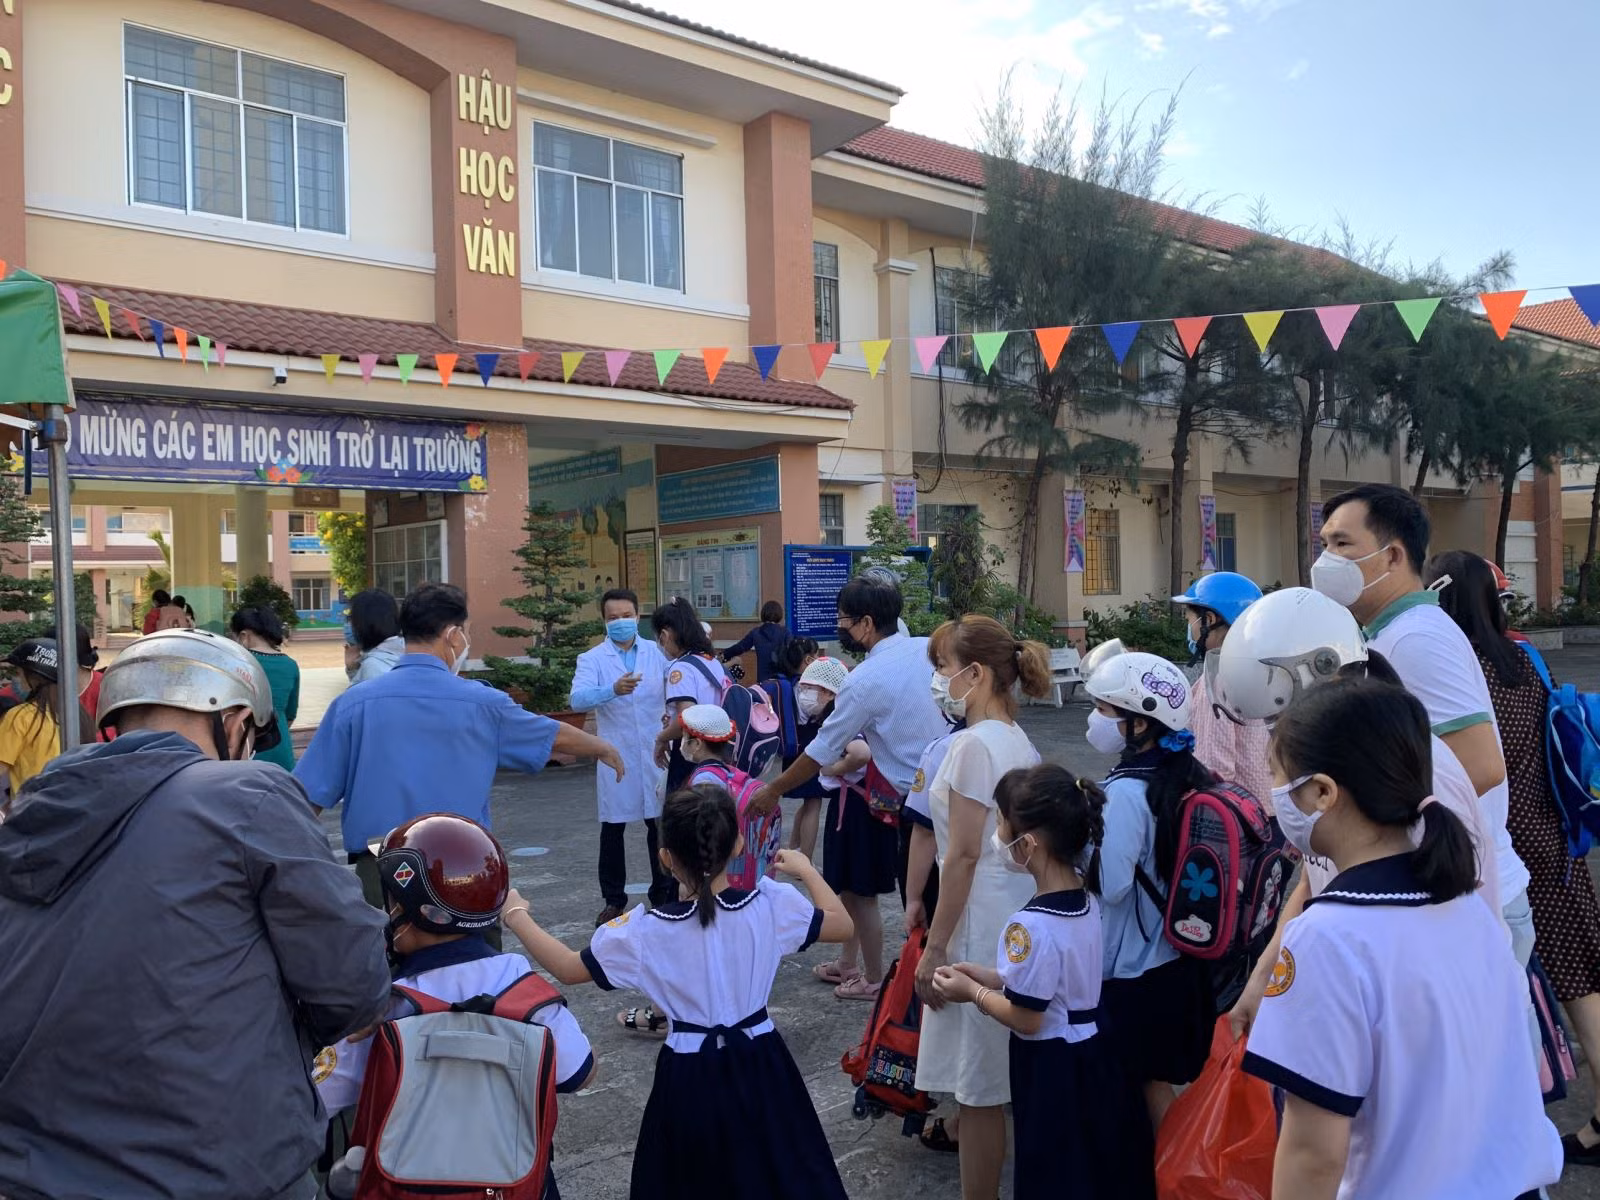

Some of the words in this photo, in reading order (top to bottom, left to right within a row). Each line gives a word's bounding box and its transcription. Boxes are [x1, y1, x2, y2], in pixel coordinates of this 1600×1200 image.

[458, 68, 512, 135] HẬU
[459, 147, 514, 210] HỌC
[463, 217, 515, 277] VĂN
[80, 405, 147, 458] MỪNG
[153, 411, 196, 461] CÁC
[202, 423, 234, 462] EM
[241, 425, 281, 470] HỌC
[287, 428, 331, 466] SINH
[336, 420, 375, 469] TRỞ
[380, 435, 409, 478] LẠI
[413, 430, 482, 475] TRƯỜNG
